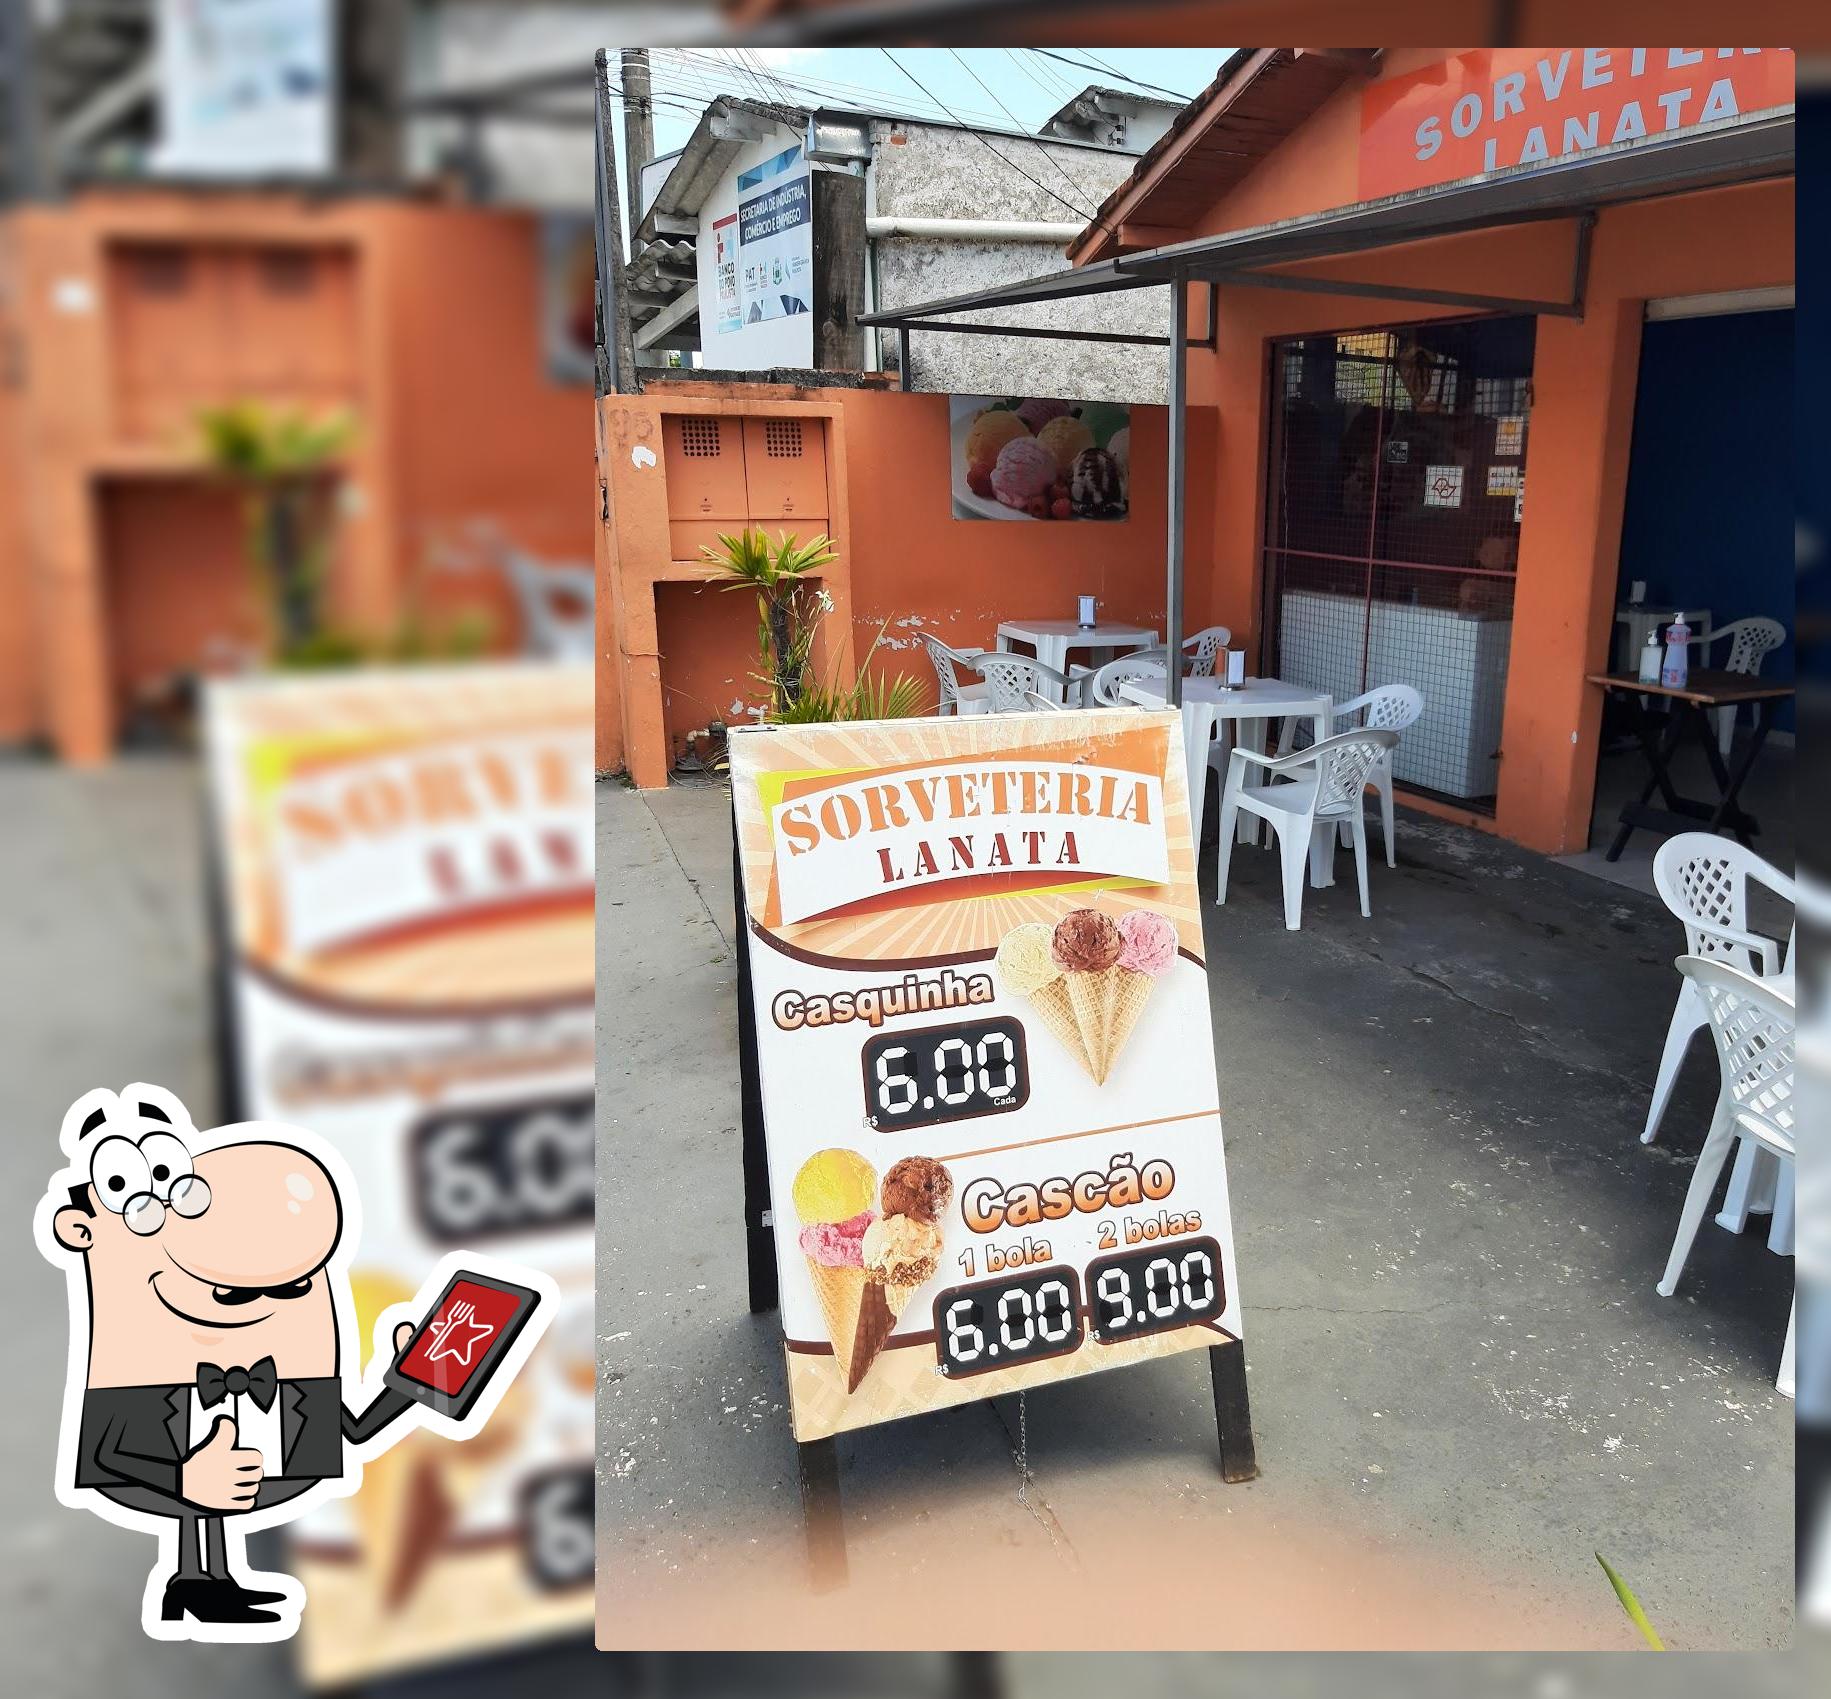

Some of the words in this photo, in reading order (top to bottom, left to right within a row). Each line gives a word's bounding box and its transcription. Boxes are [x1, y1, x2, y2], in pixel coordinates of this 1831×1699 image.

[1484, 78, 1740, 172] LANATA
[741, 200, 768, 222] SECRETARIA
[769, 197, 776, 211] DE
[776, 184, 807, 208] INDÚSTRIA,
[745, 219, 772, 240] COMÉRCIO
[776, 208, 801, 229] EMPREGO
[780, 771, 1152, 856] SORVETERIA
[877, 831, 1080, 884] LANATA
[771, 970, 995, 1031] Casquinha
[862, 1115, 879, 1129] R$
[875, 1032, 1017, 1115] 6.00
[993, 1094, 1017, 1106] Cada
[961, 1152, 1176, 1234] Cascão
[958, 1247, 976, 1277] 1
[986, 1237, 1053, 1273] bola
[1097, 1220, 1118, 1250] 2
[1123, 1210, 1202, 1245] bolas
[1087, 1330, 1100, 1342] R$
[1096, 1251, 1215, 1328] 9.00
[934, 1363, 949, 1376] R$
[946, 1280, 1072, 1362] 6.00
